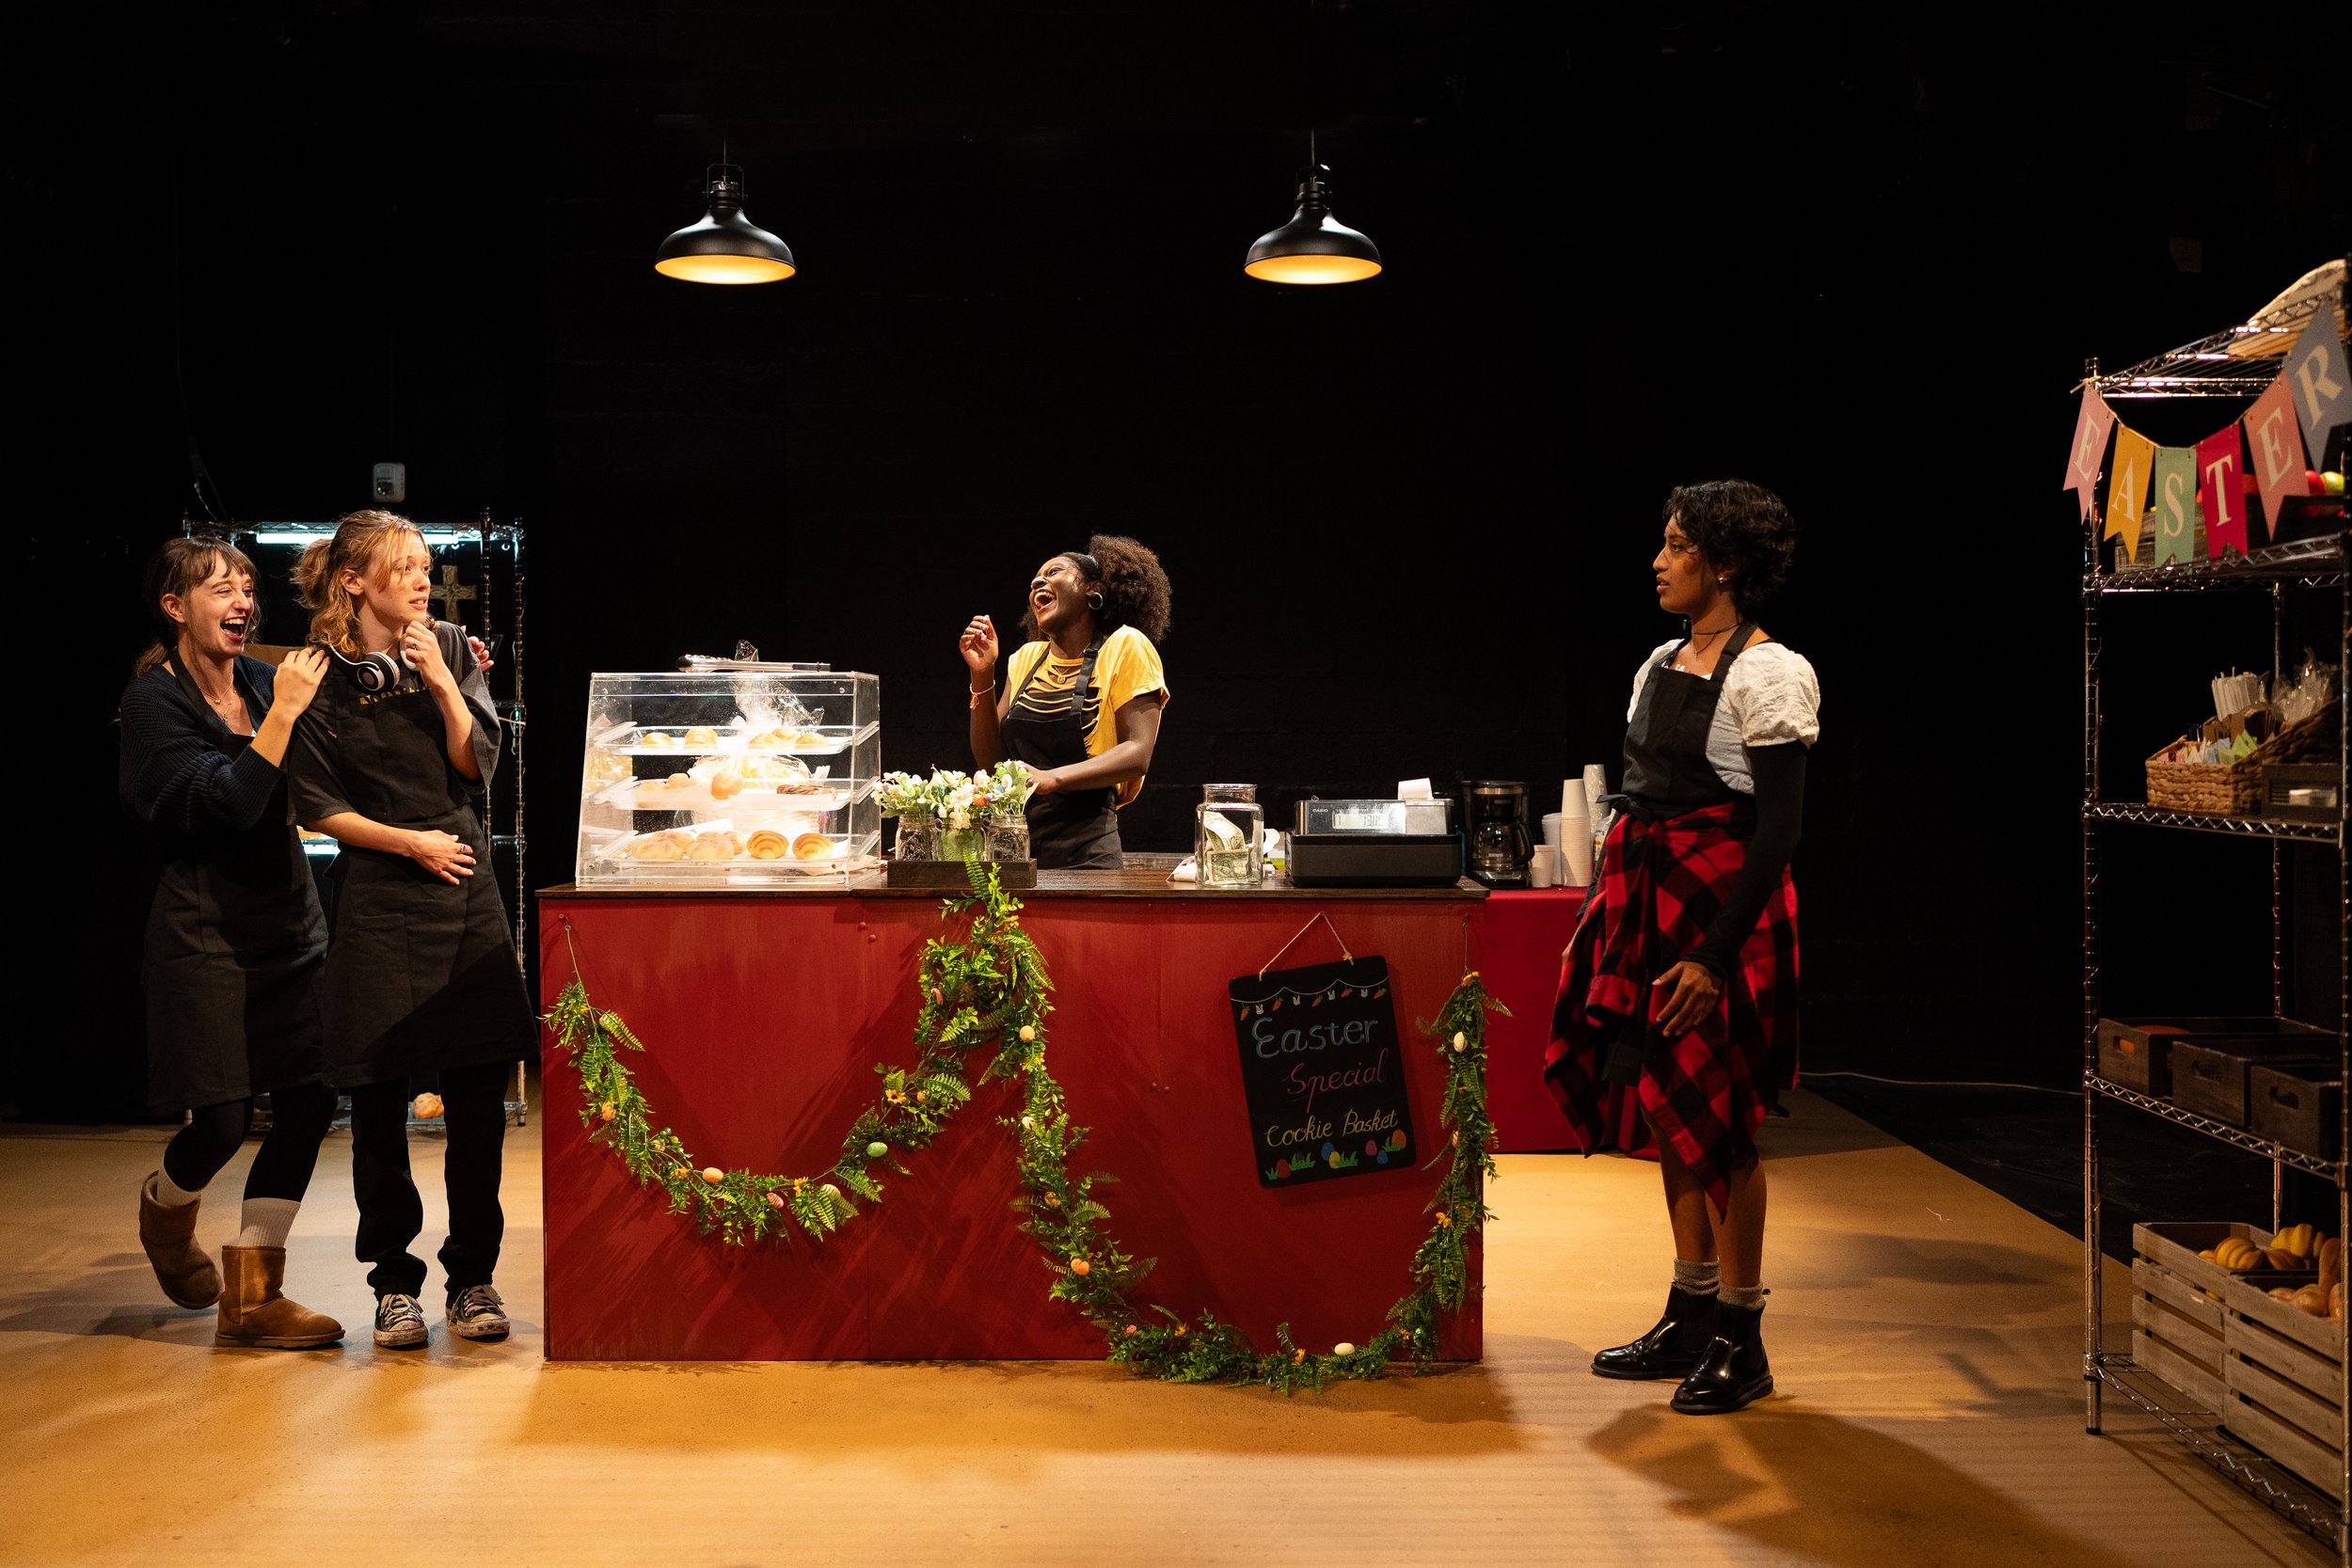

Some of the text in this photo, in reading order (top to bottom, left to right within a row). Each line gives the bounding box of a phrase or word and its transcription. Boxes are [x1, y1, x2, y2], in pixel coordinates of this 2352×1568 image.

[2074, 344, 2343, 538] EASTER
[1252, 1017, 1378, 1059] Easter
[1283, 1048, 1389, 1114] Special
[1263, 1109, 1399, 1148] Cookie Basket
